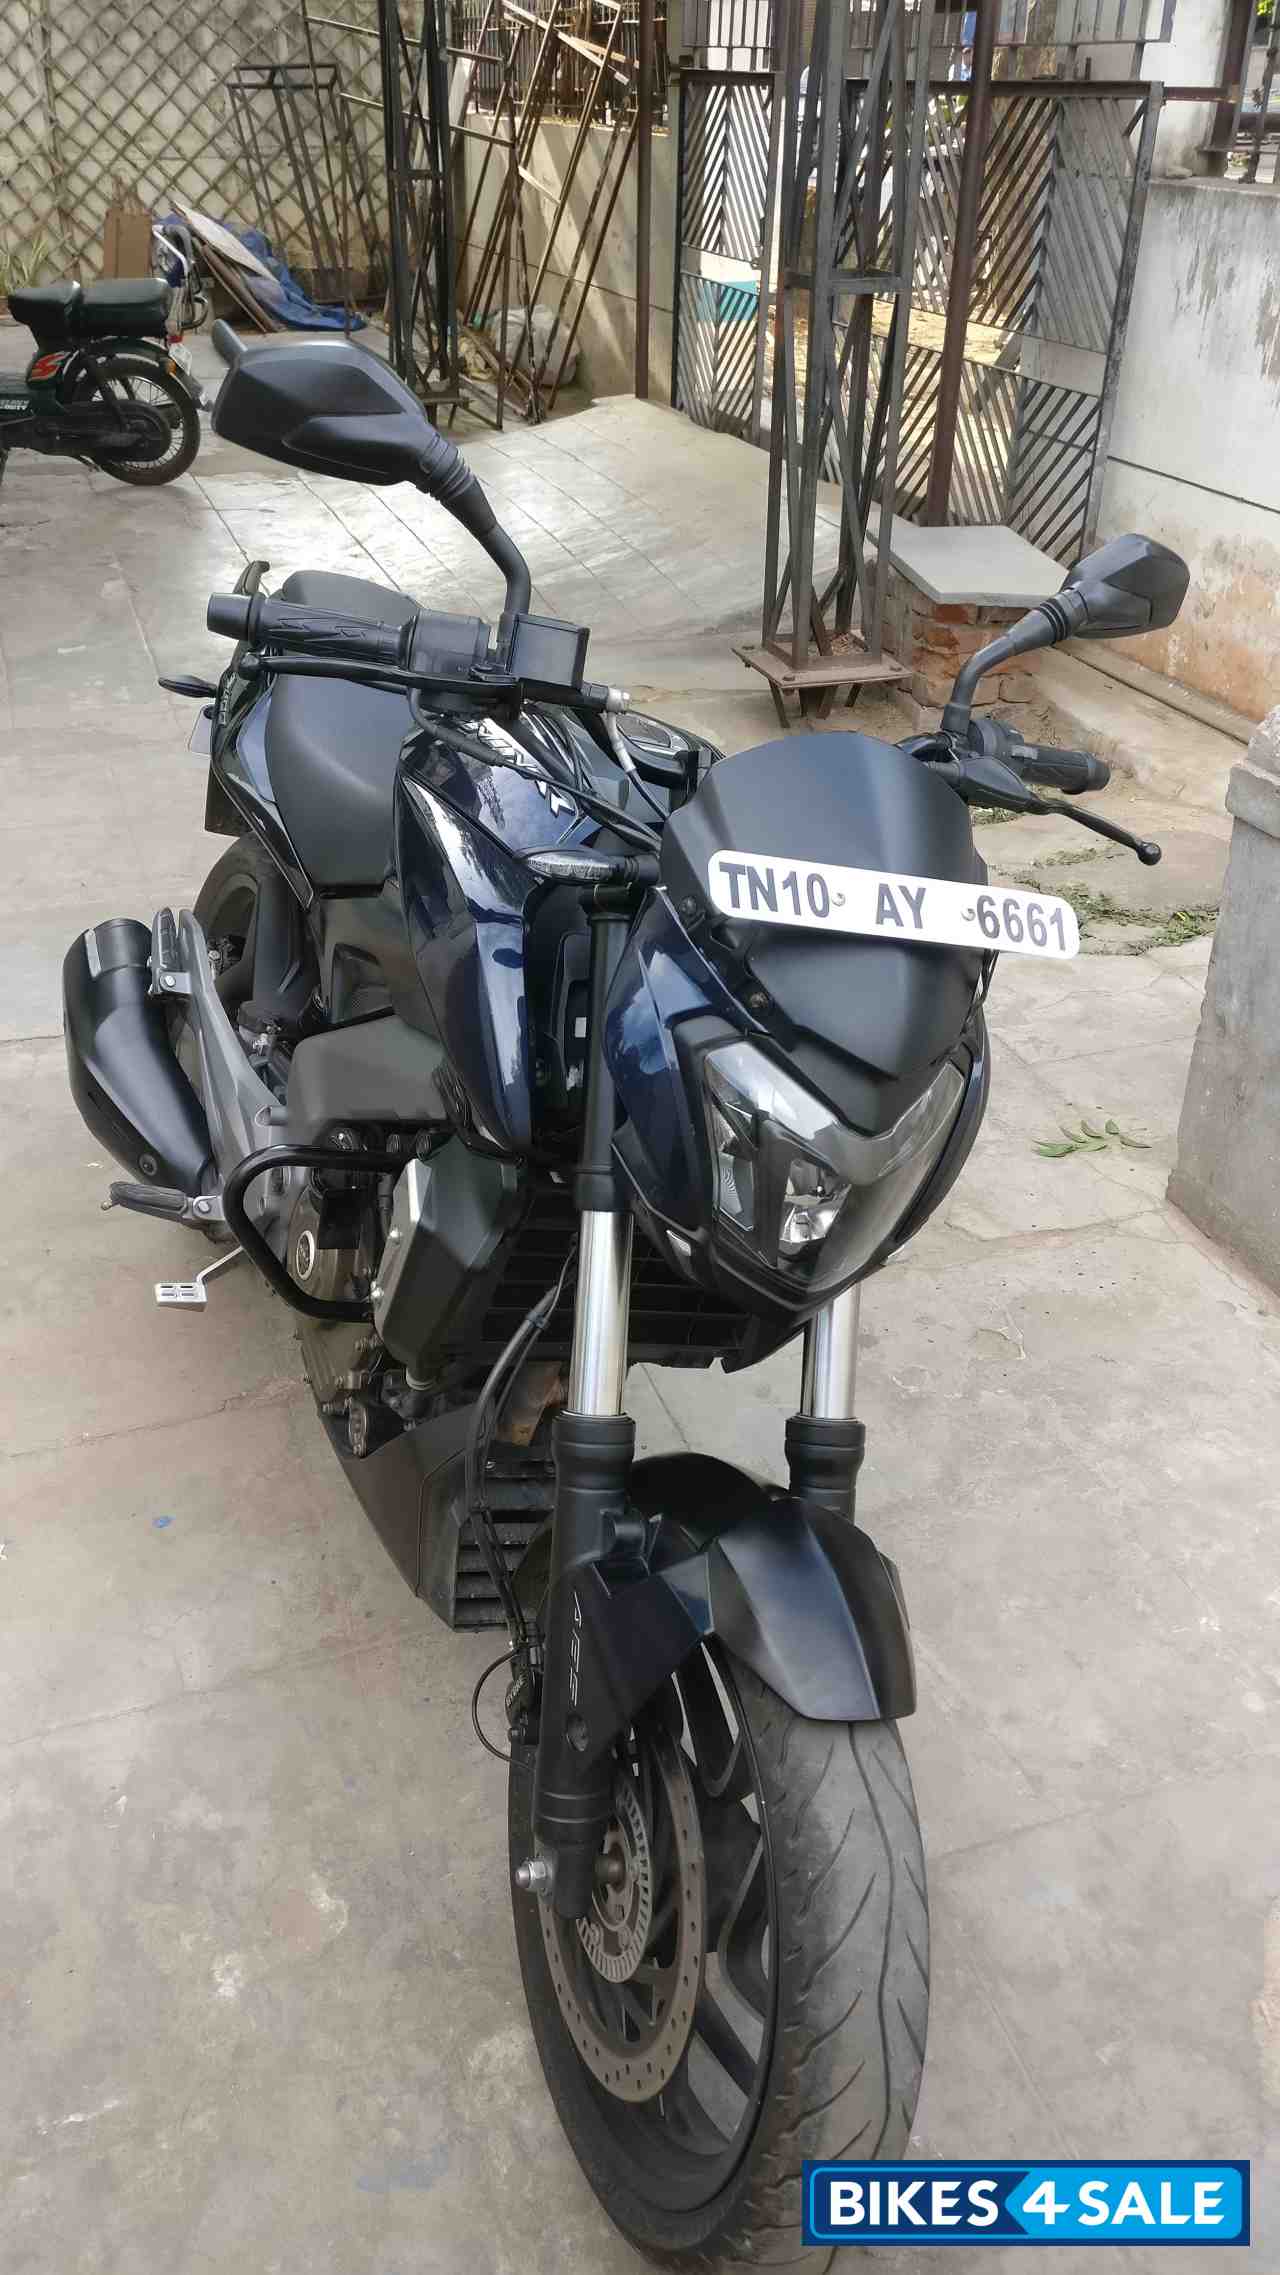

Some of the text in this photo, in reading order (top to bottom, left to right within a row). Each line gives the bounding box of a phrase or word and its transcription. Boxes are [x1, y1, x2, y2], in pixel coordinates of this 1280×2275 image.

[718, 861, 1066, 951] TN10 AY 6661
